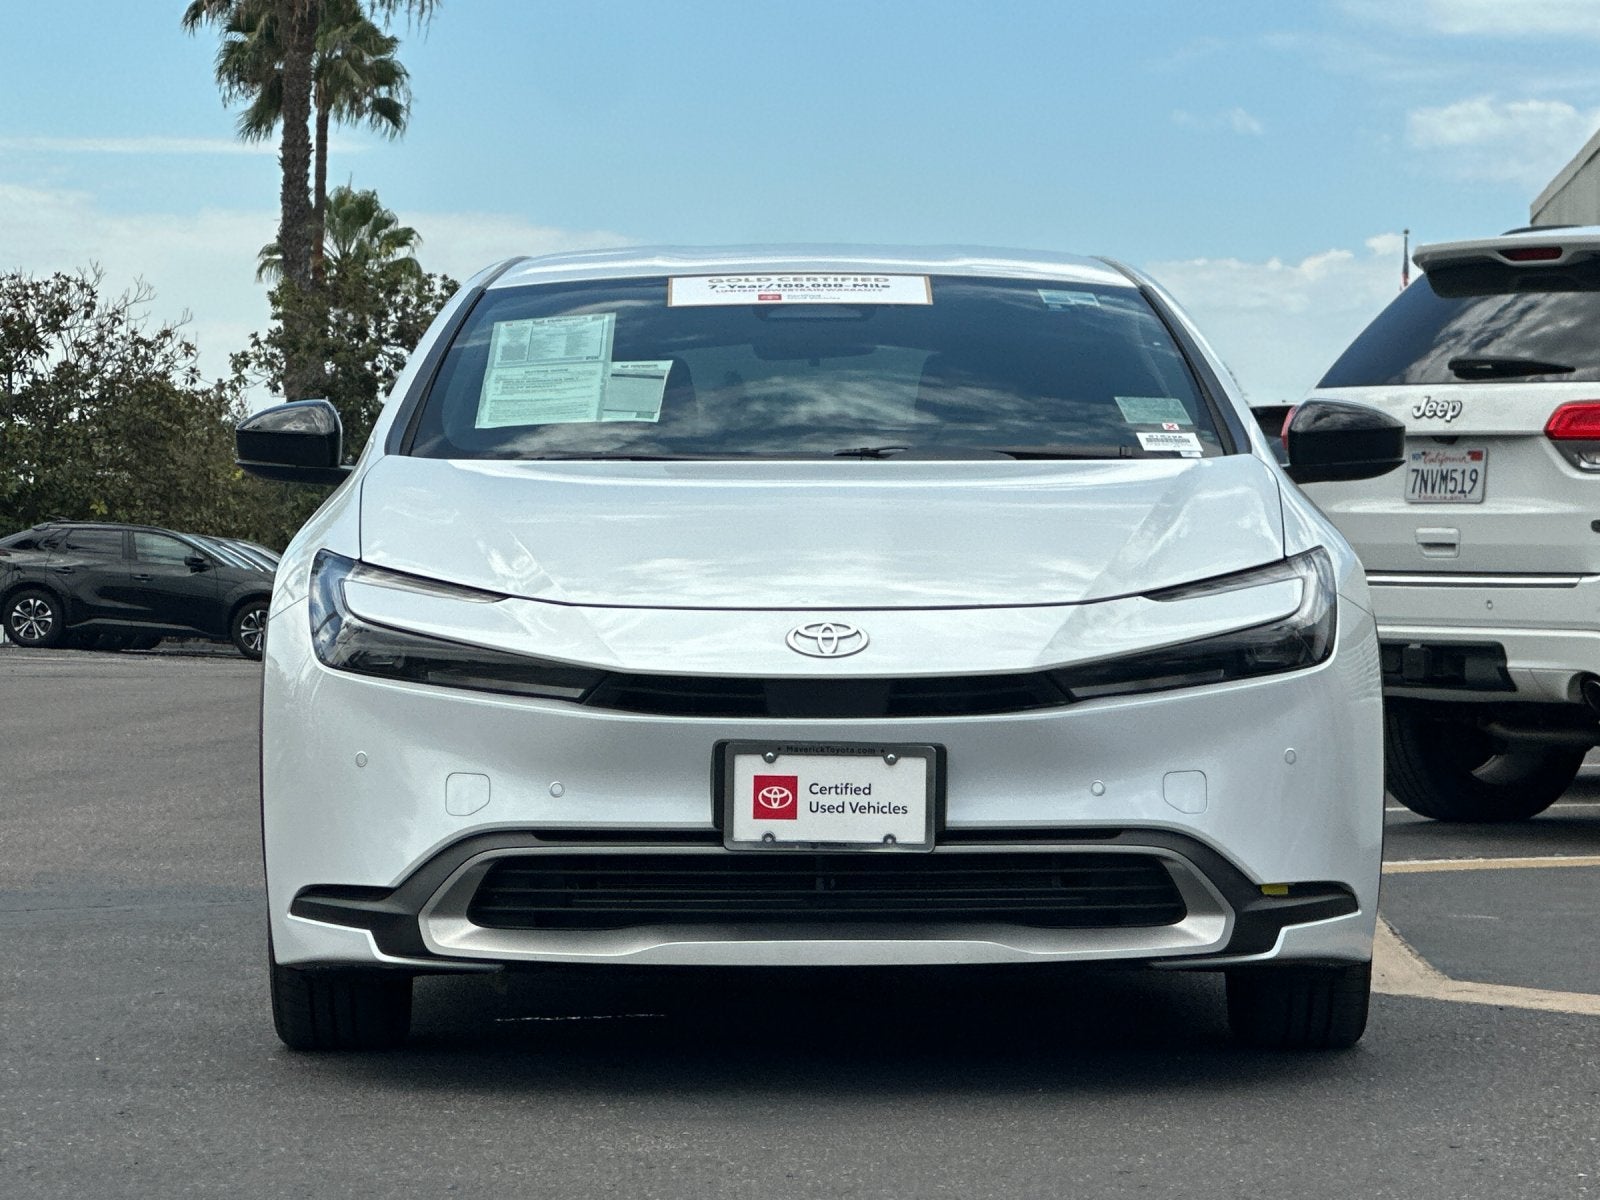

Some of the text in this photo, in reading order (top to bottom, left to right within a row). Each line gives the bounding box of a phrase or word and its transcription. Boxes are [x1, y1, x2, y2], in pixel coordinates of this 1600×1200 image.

[1412, 395, 1463, 423] Jeep
[1411, 468, 1479, 495] 7NVM519
[786, 745, 876, 755] MaverickToyota.com
[808, 782, 872, 796] Certified
[808, 801, 909, 815] Used Vehicles
